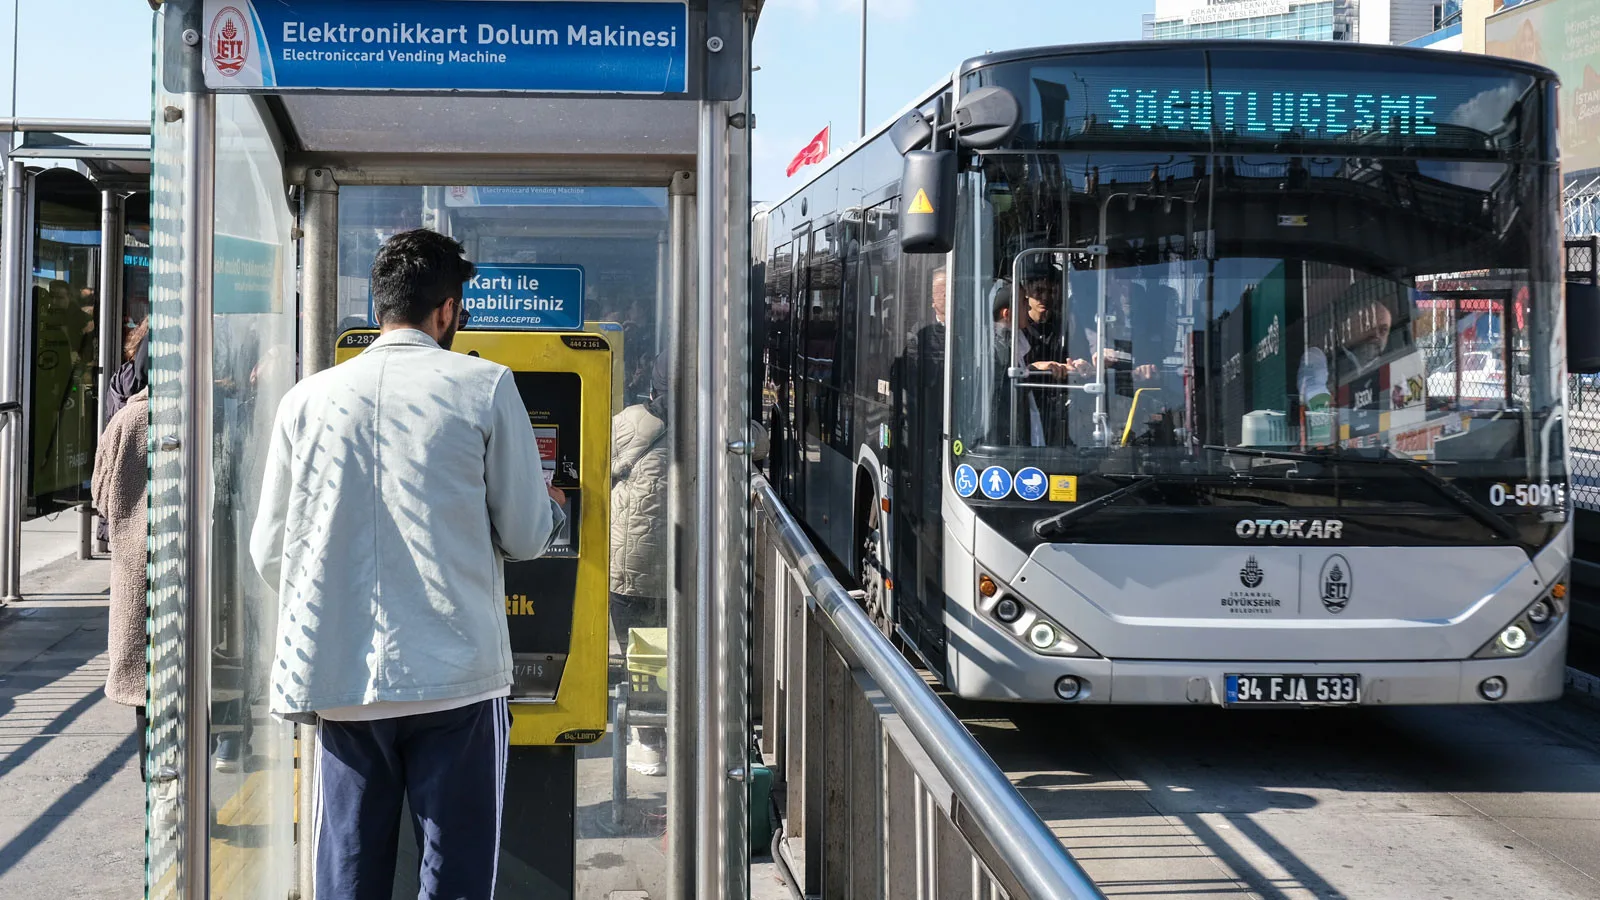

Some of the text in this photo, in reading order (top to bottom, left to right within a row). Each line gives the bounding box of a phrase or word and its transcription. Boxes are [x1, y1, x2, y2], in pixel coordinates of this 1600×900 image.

[1190, 8, 1217, 17] ERKAN
[1228, 10, 1259, 19] MESLEK
[282, 21, 677, 47] Elektronikkart Dolum Makinesi
[282, 49, 507, 65] Electroniccard Vending Machine
[530, 187, 556, 196] Vending
[557, 187, 585, 195] Machine
[468, 274, 540, 291] Kartı ile
[472, 315, 499, 323] CARDS
[499, 316, 541, 324] ACCEPTED
[569, 340, 582, 348] 444
[1235, 519, 1344, 539] OTOKAR
[1221, 597, 1281, 608] BÜYÜKŞEHİR
[1238, 677, 1354, 701] 34 FJA 533
